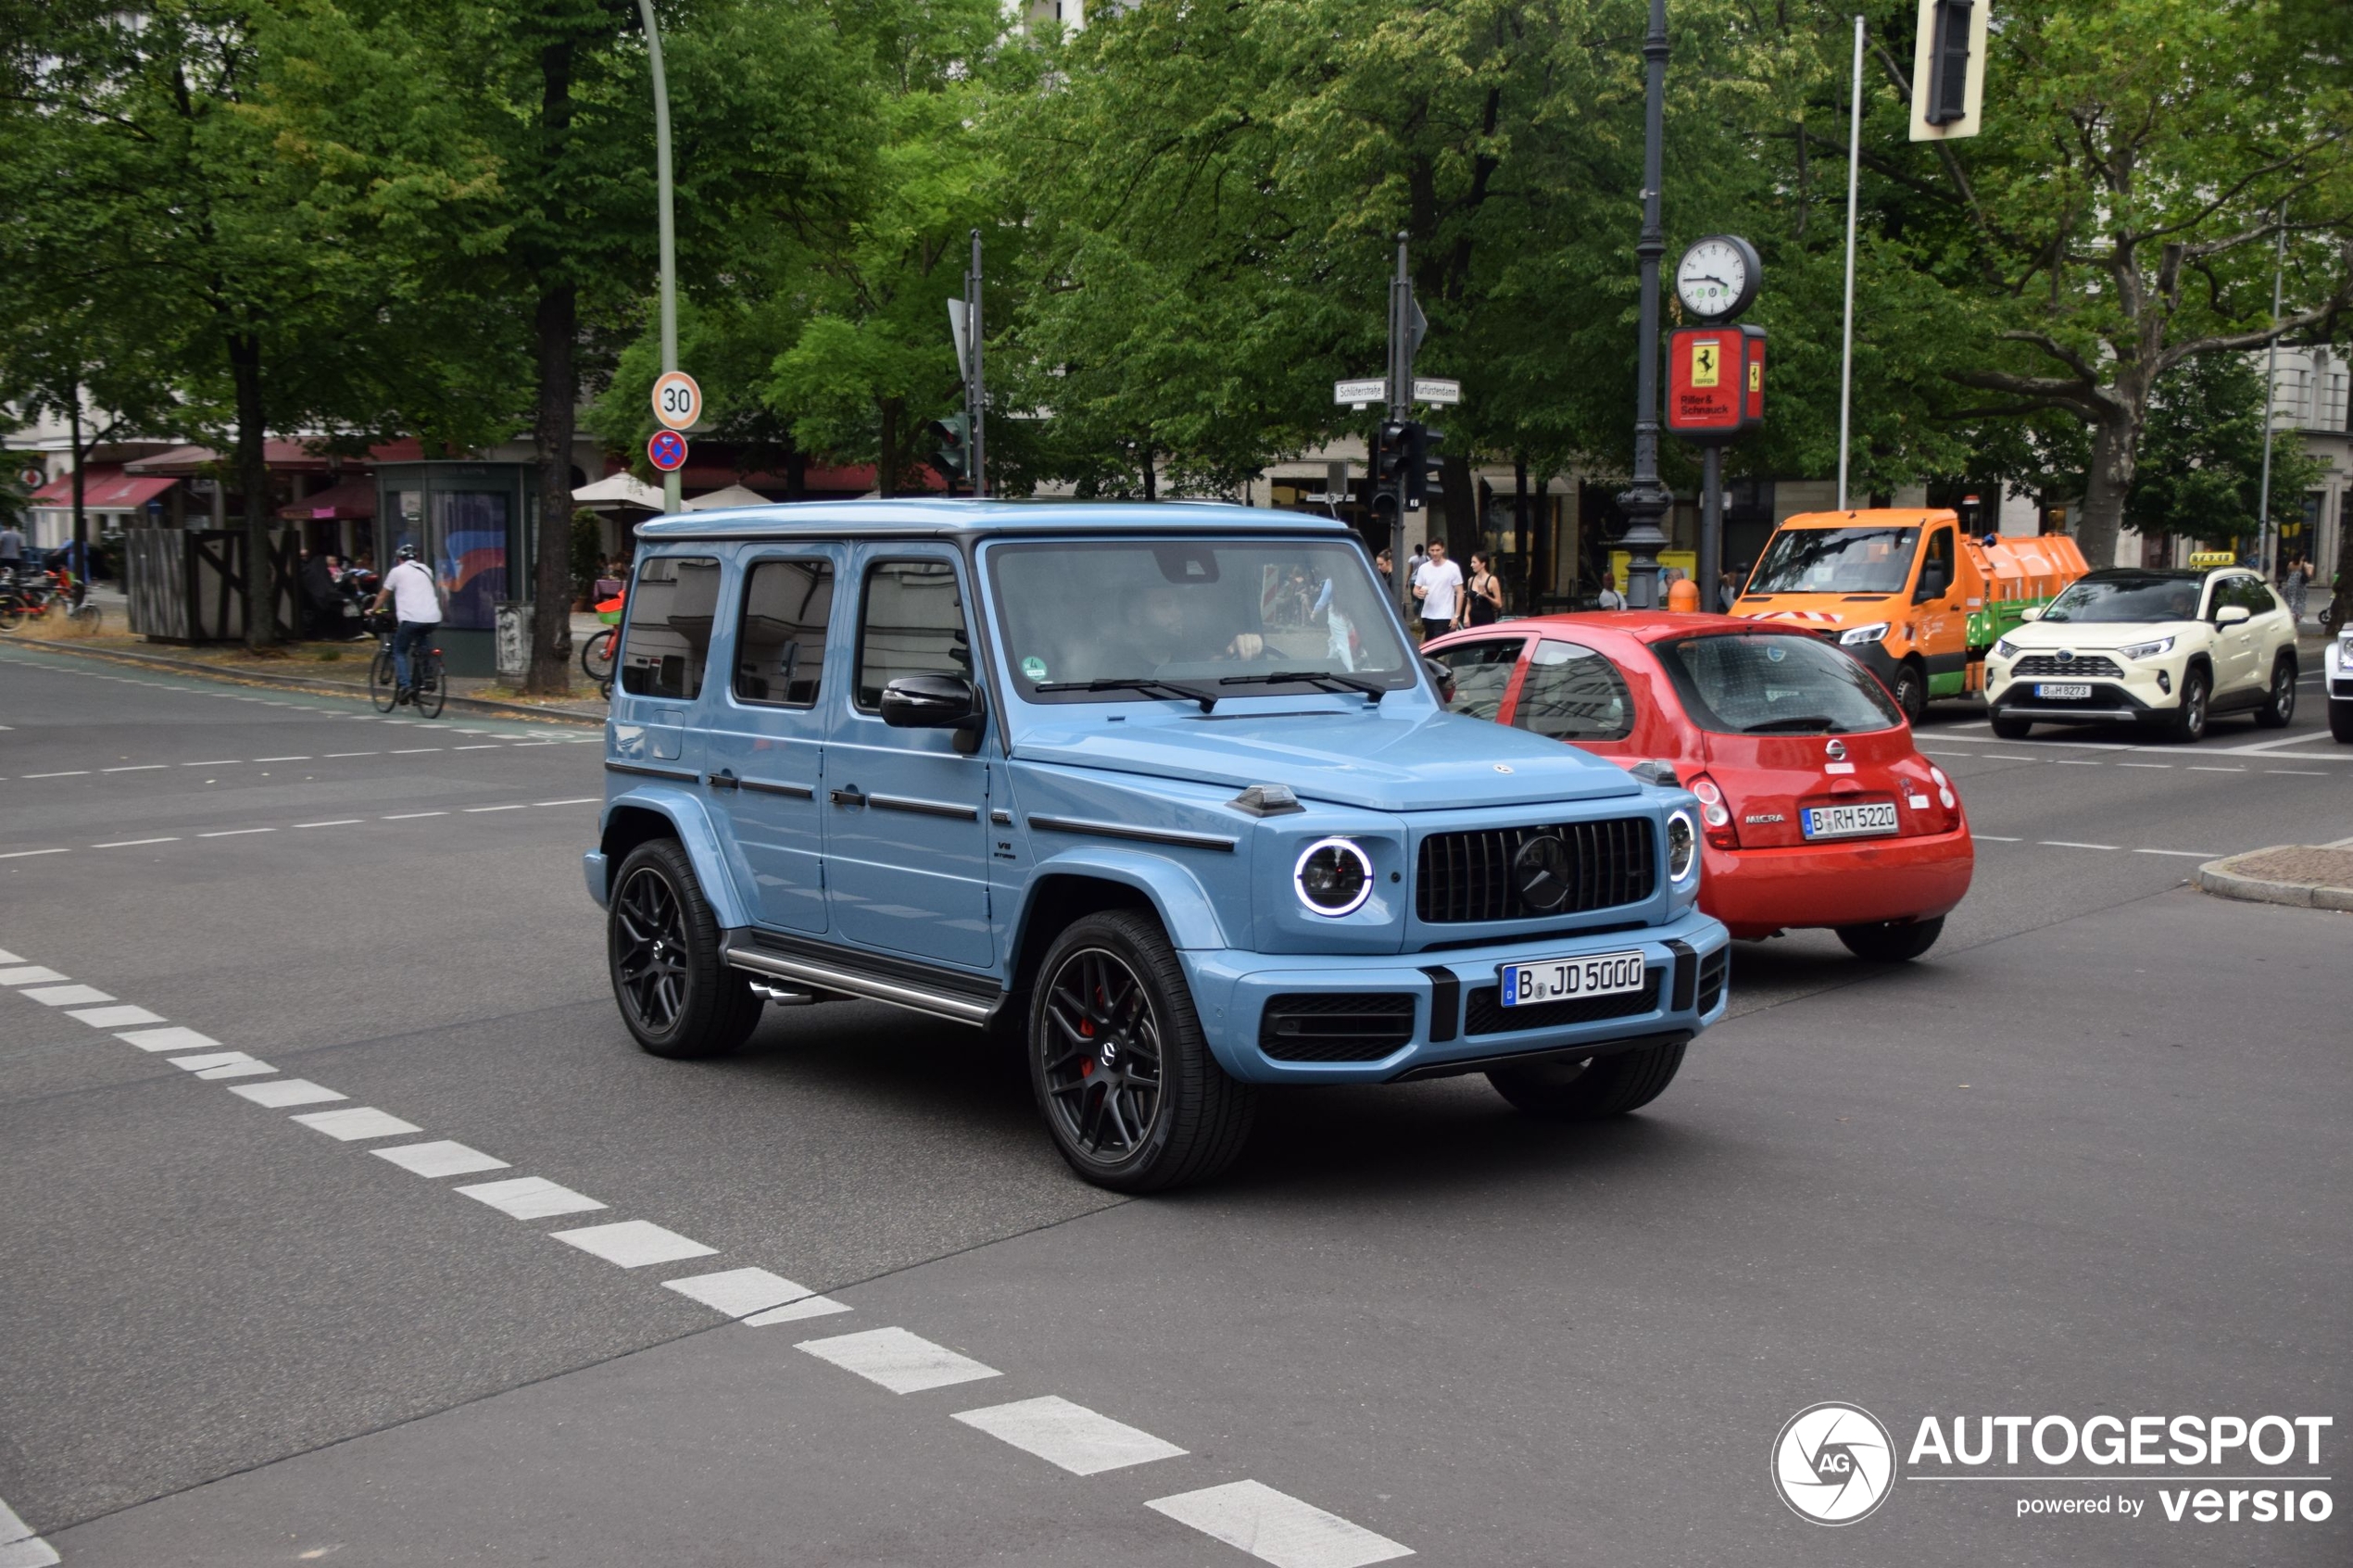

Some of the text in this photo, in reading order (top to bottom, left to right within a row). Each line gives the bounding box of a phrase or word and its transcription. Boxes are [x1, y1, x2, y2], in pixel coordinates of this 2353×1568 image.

[1415, 383, 1456, 397] Kurfürstendamm
[664, 388, 690, 413] 30
[1680, 395, 1713, 405] Riller &
[1680, 405, 1729, 415] Schnauck
[2043, 685, 2086, 696] B H 8273
[1745, 813, 1784, 823] MICRA
[1813, 806, 1894, 831] B RH 5220
[1519, 958, 1641, 999] B JD 5000
